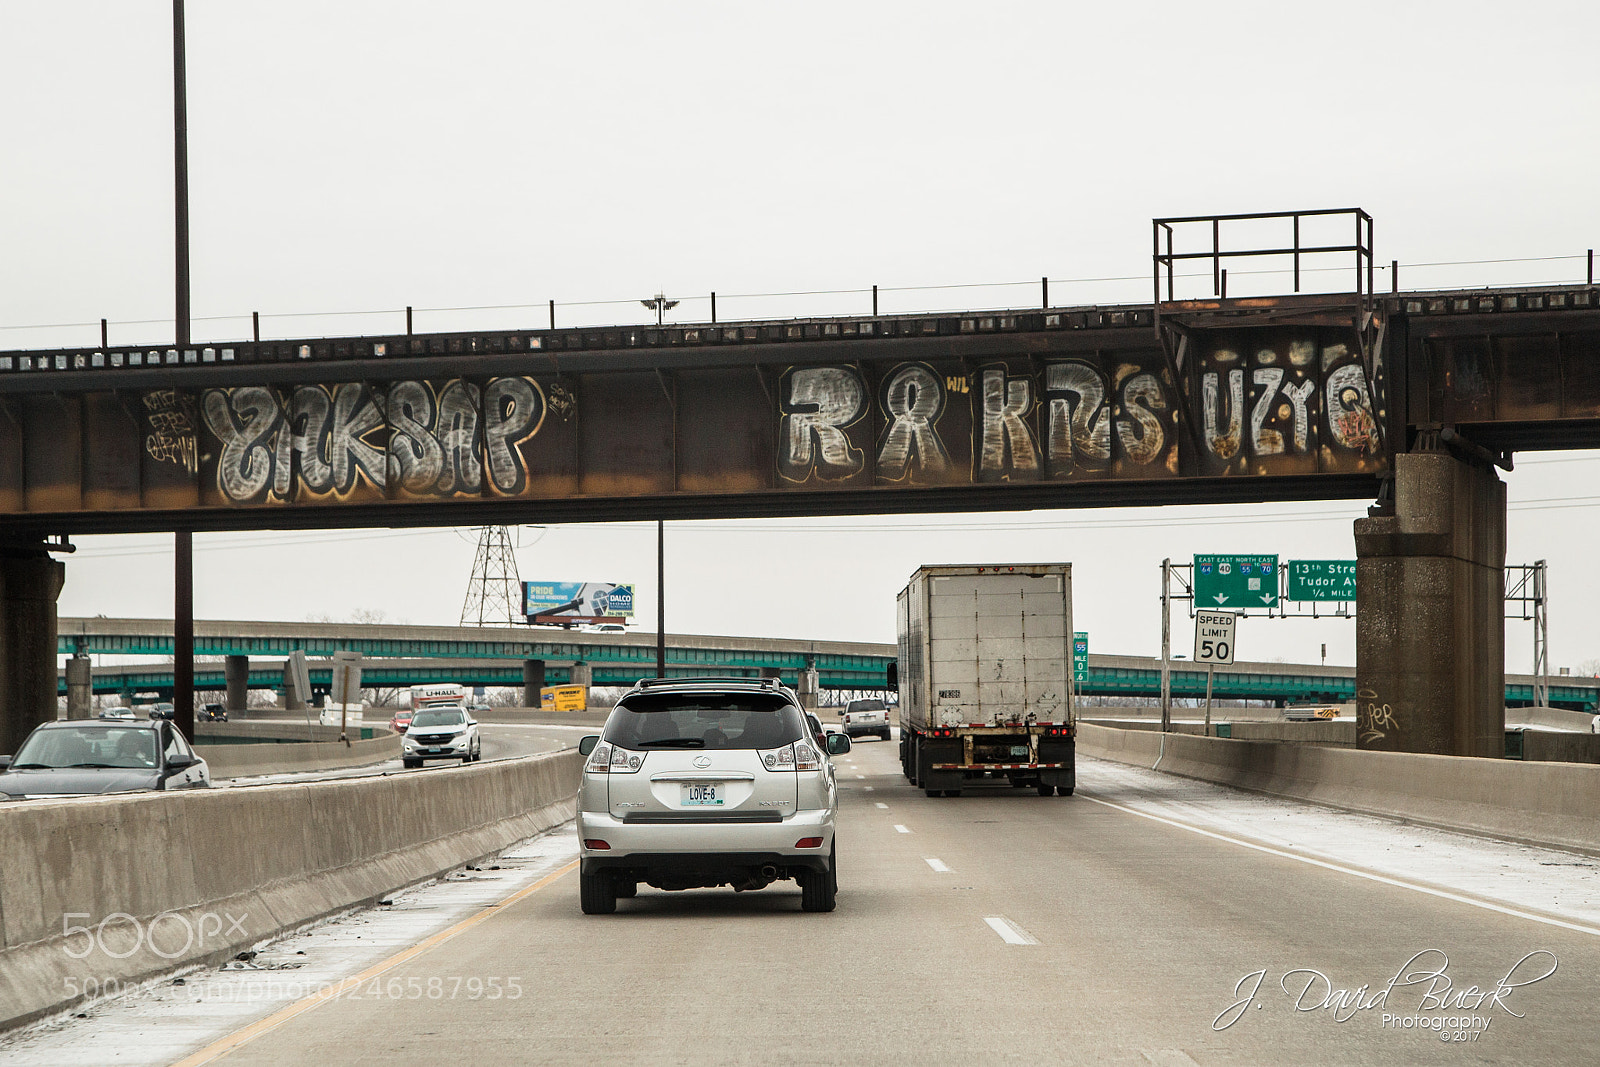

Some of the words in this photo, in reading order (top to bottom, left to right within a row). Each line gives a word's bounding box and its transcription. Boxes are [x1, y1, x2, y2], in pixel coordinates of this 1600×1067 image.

[1219, 565, 1231, 573] 40
[1295, 564, 1322, 574] 13th
[1298, 576, 1336, 586] Tudor
[530, 586, 554, 595] PRIDE
[1199, 615, 1233, 626] SPEED
[1201, 628, 1229, 638] LIMIT
[1200, 640, 1230, 661] 50
[1078, 662, 1084, 671] 0
[425, 689, 457, 697] U-HAUL
[689, 787, 716, 800] LOVE-8
